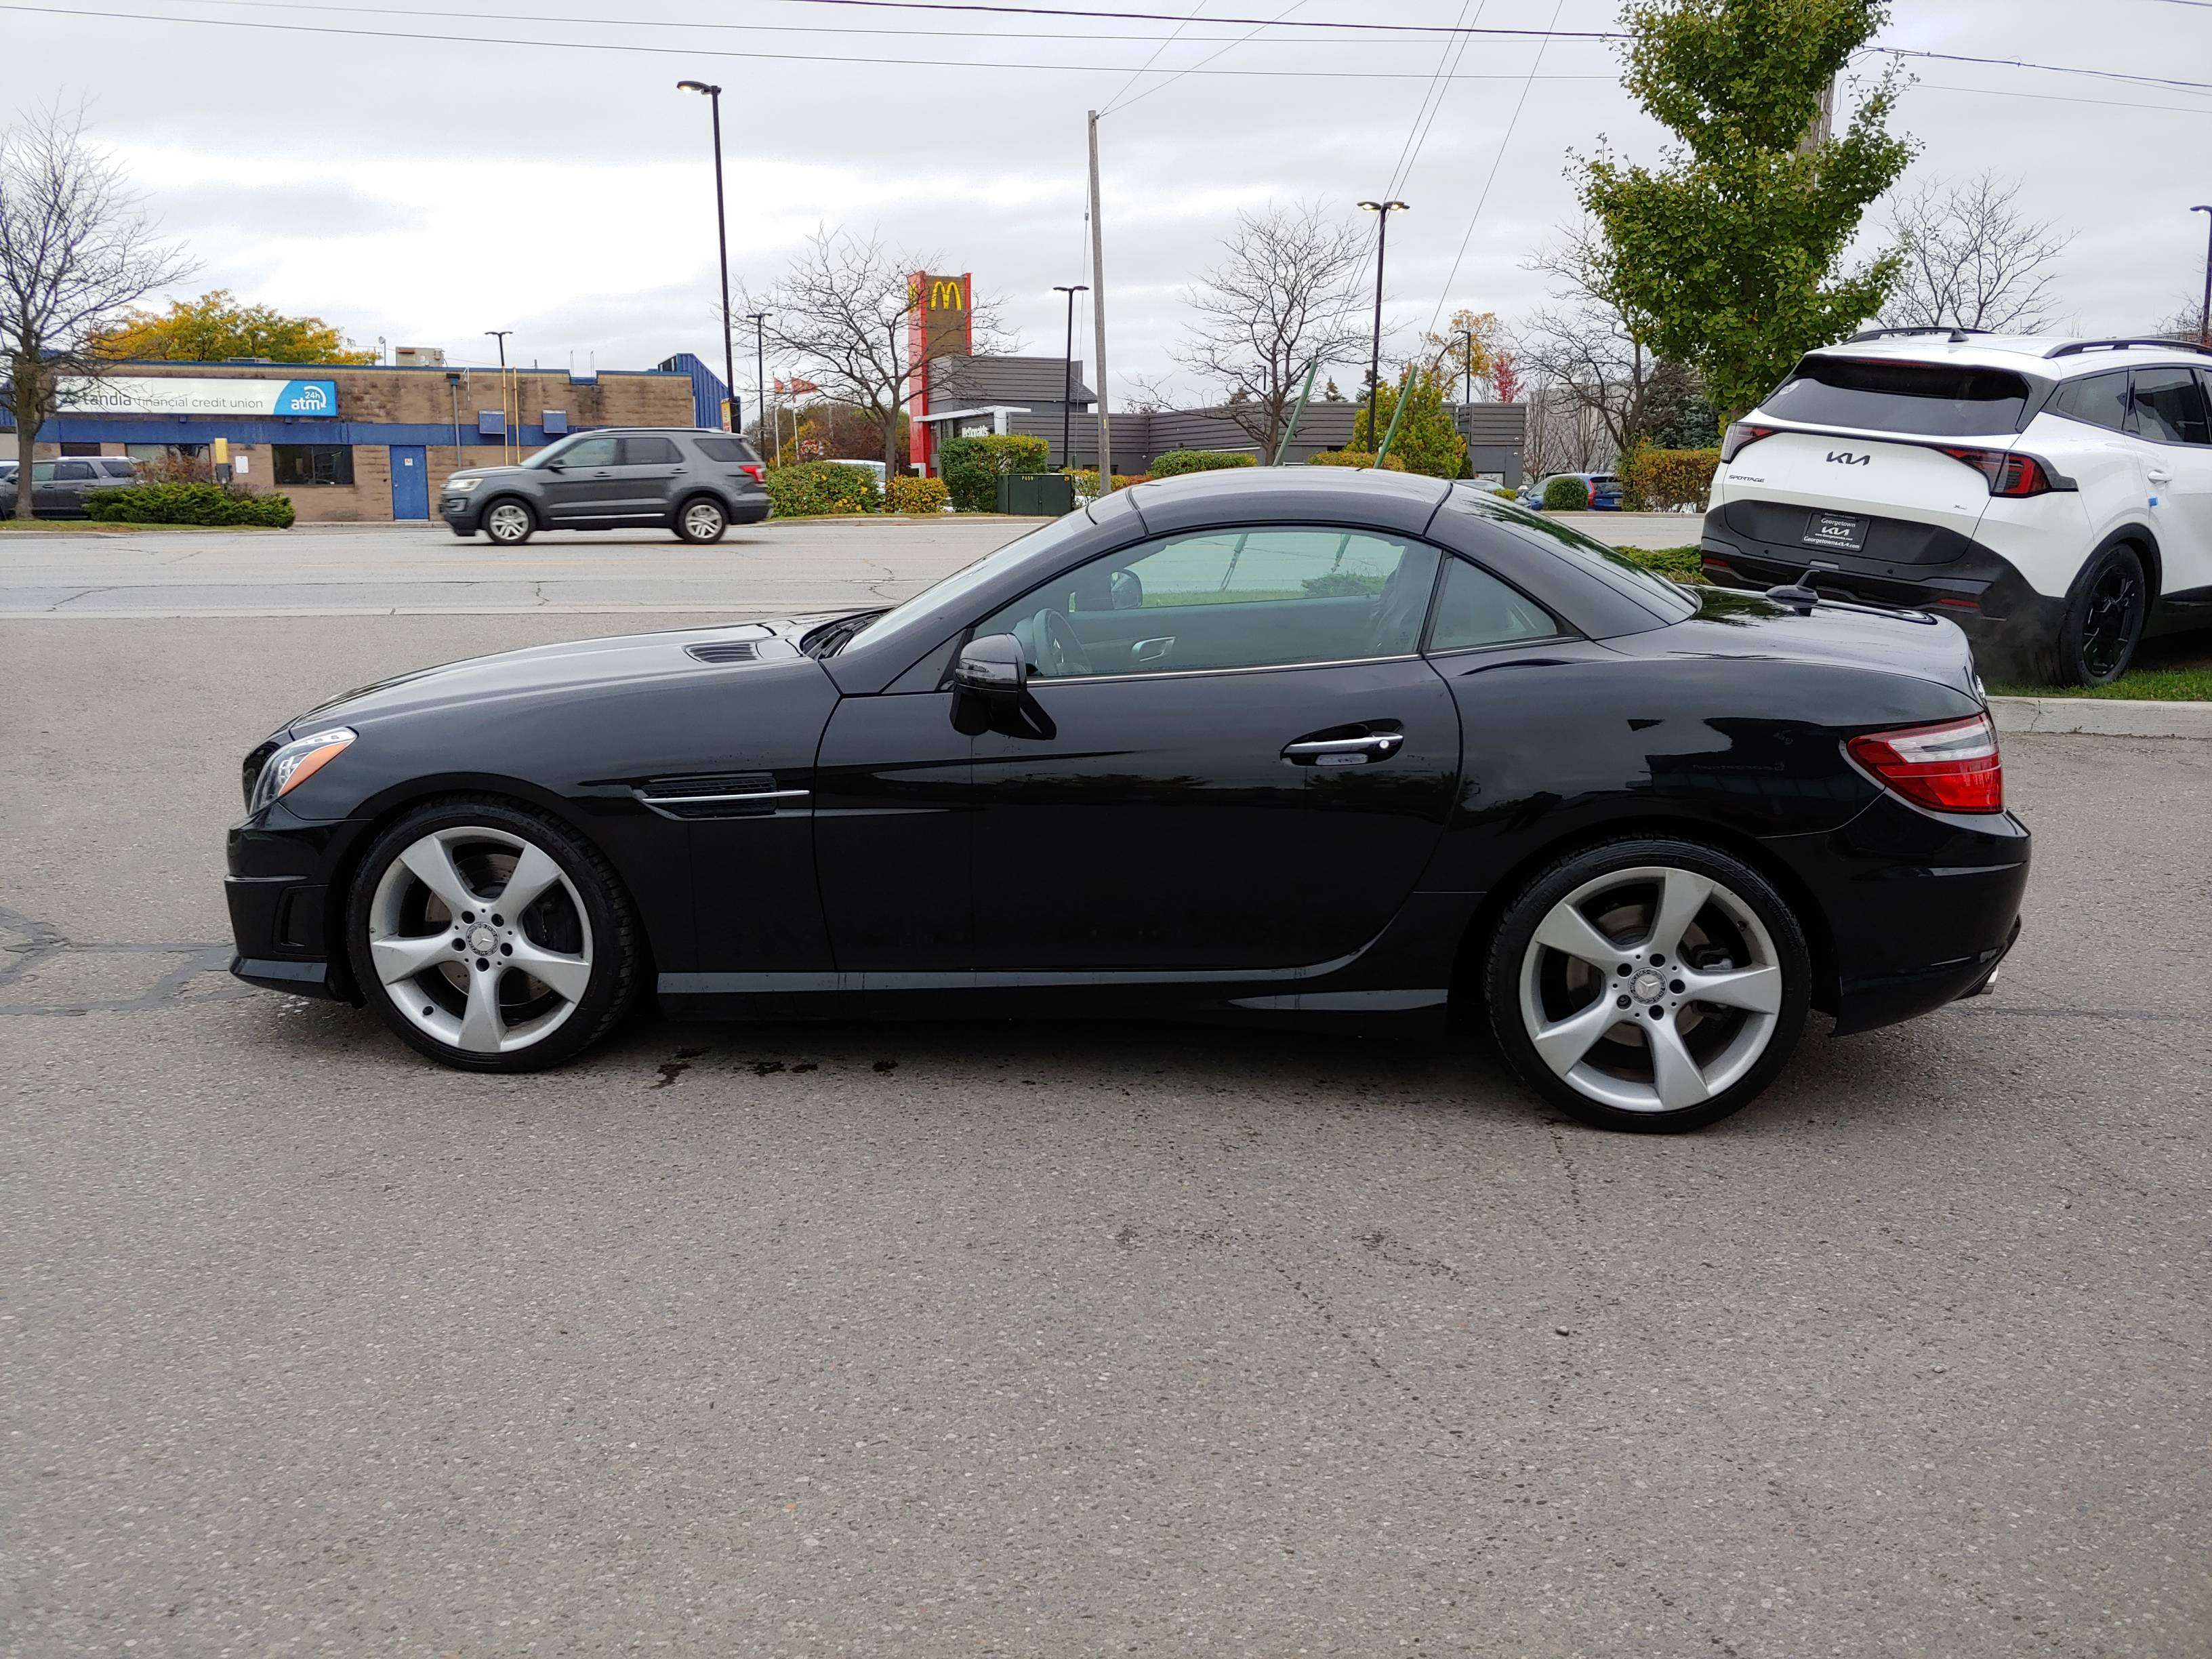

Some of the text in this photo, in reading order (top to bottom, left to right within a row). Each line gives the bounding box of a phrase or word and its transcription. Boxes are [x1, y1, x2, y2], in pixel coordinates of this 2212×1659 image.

[305, 391, 320, 399] 24h
[138, 396, 188, 407] financial
[192, 398, 226, 407] credit
[230, 398, 263, 408] union
[291, 397, 321, 410] atm
[1826, 451, 1870, 466] KIA
[1821, 518, 1856, 527] Georgetown
[1821, 526, 1850, 536] KIA
